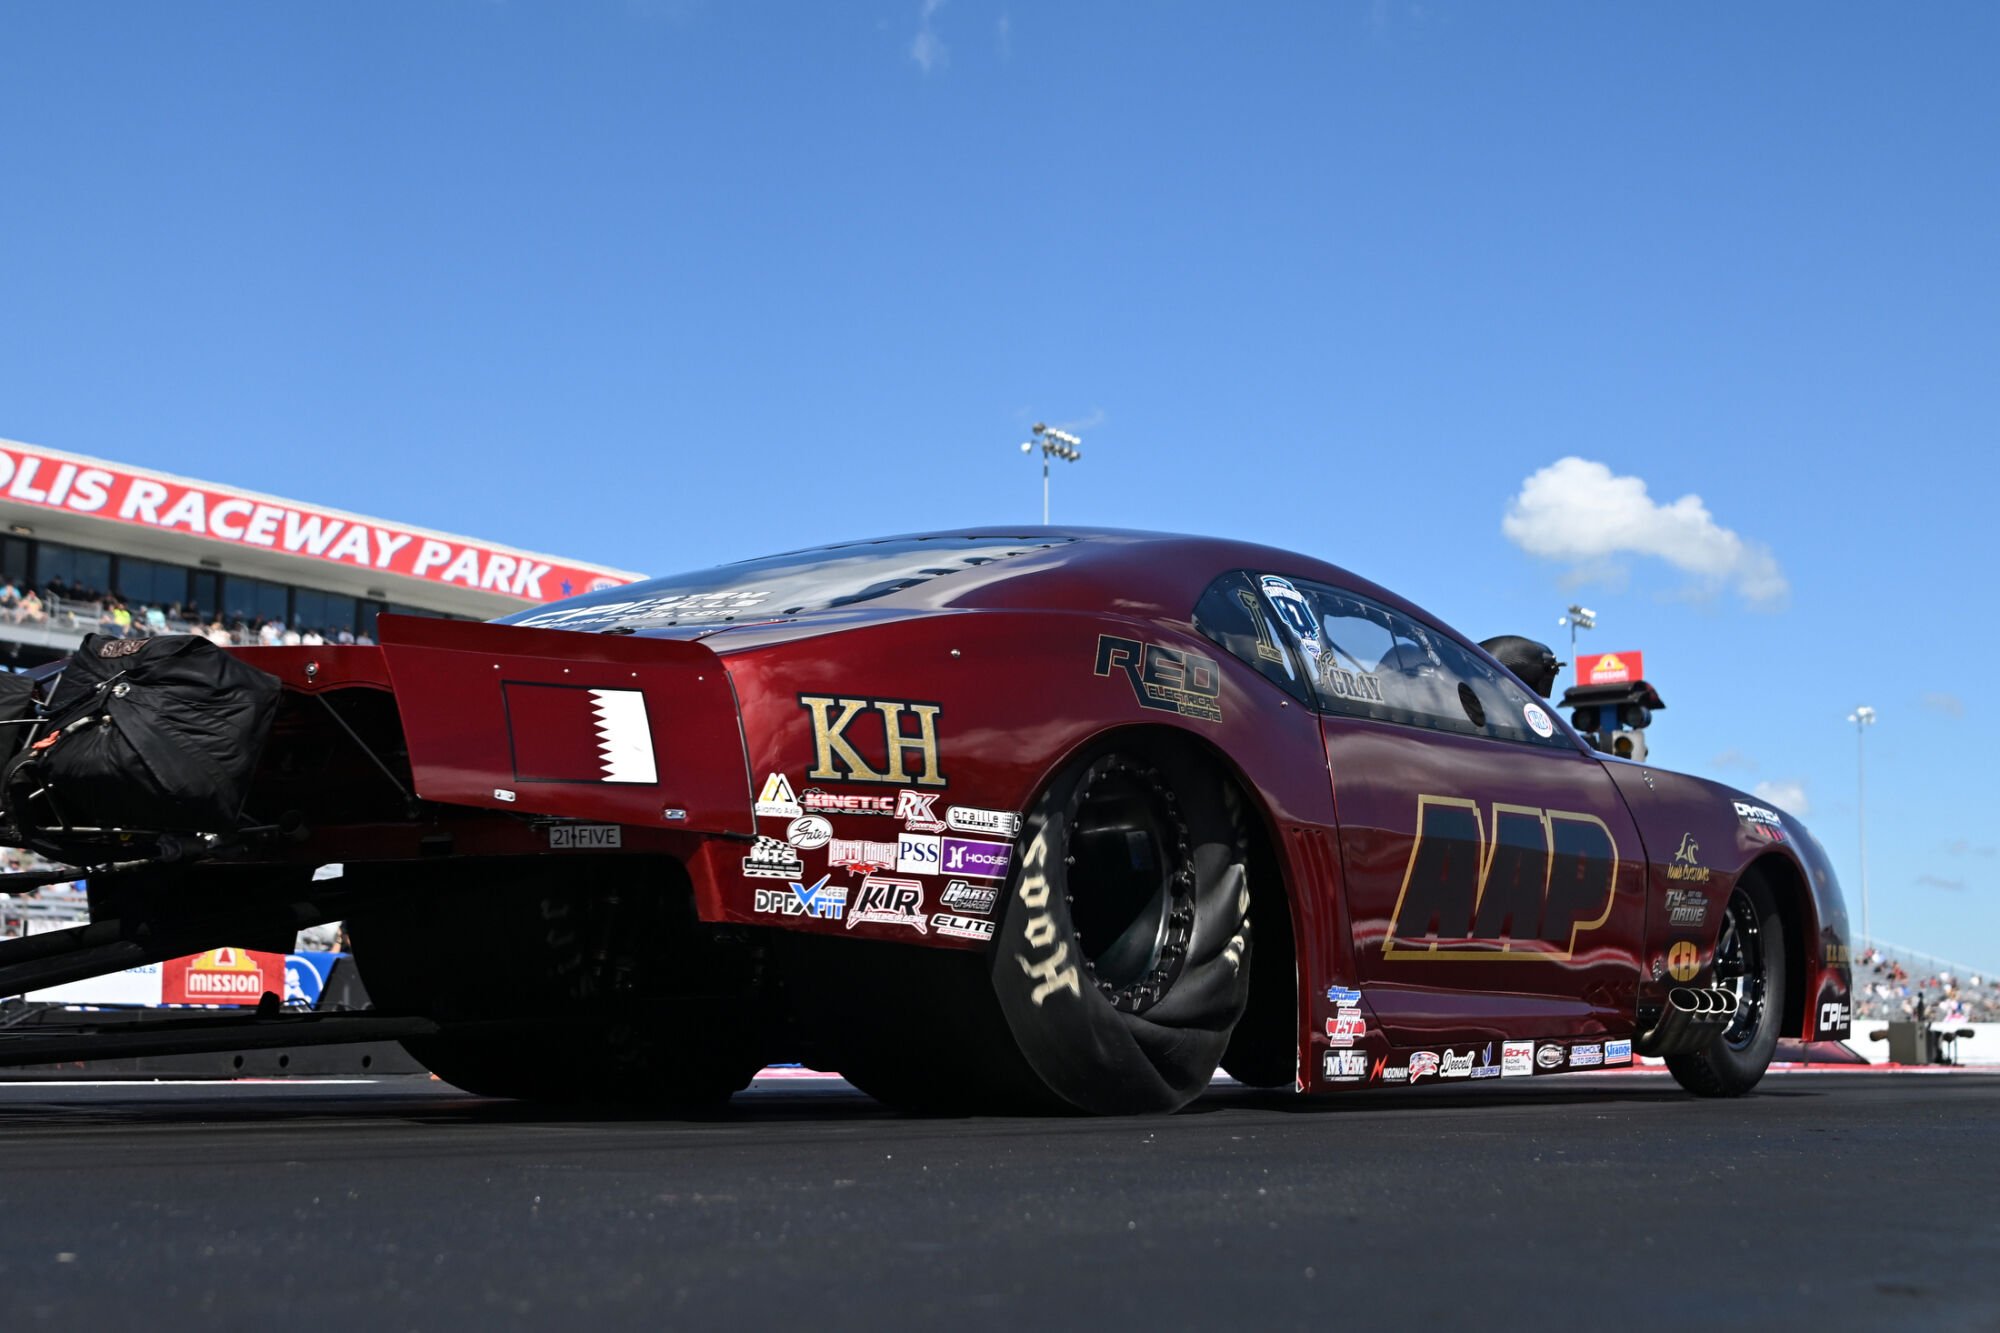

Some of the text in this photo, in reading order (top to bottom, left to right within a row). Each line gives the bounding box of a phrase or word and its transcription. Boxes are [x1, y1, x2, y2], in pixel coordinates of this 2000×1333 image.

[118, 477, 412, 568] RACEWAY
[411, 538, 552, 599] PARK
[1094, 633, 1220, 713] RED
[1328, 667, 1385, 704] GRAY
[800, 695, 947, 786] KH
[804, 791, 895, 811] KINETIC
[895, 789, 940, 823] RK
[952, 808, 1000, 823] braille
[790, 819, 831, 846] Gates
[900, 841, 938, 863] PSS
[965, 852, 1009, 867] HOOSIER
[1381, 794, 1619, 961] AAP
[942, 882, 996, 902] HARTS
[935, 915, 995, 934] ELITE
[189, 971, 259, 993] MISSION
[1820, 1003, 1842, 1031] CPI
[1441, 1051, 1474, 1073] Deecell
[1504, 1048, 1531, 1061] BOHR
[1383, 1067, 1408, 1079] NOONAN
